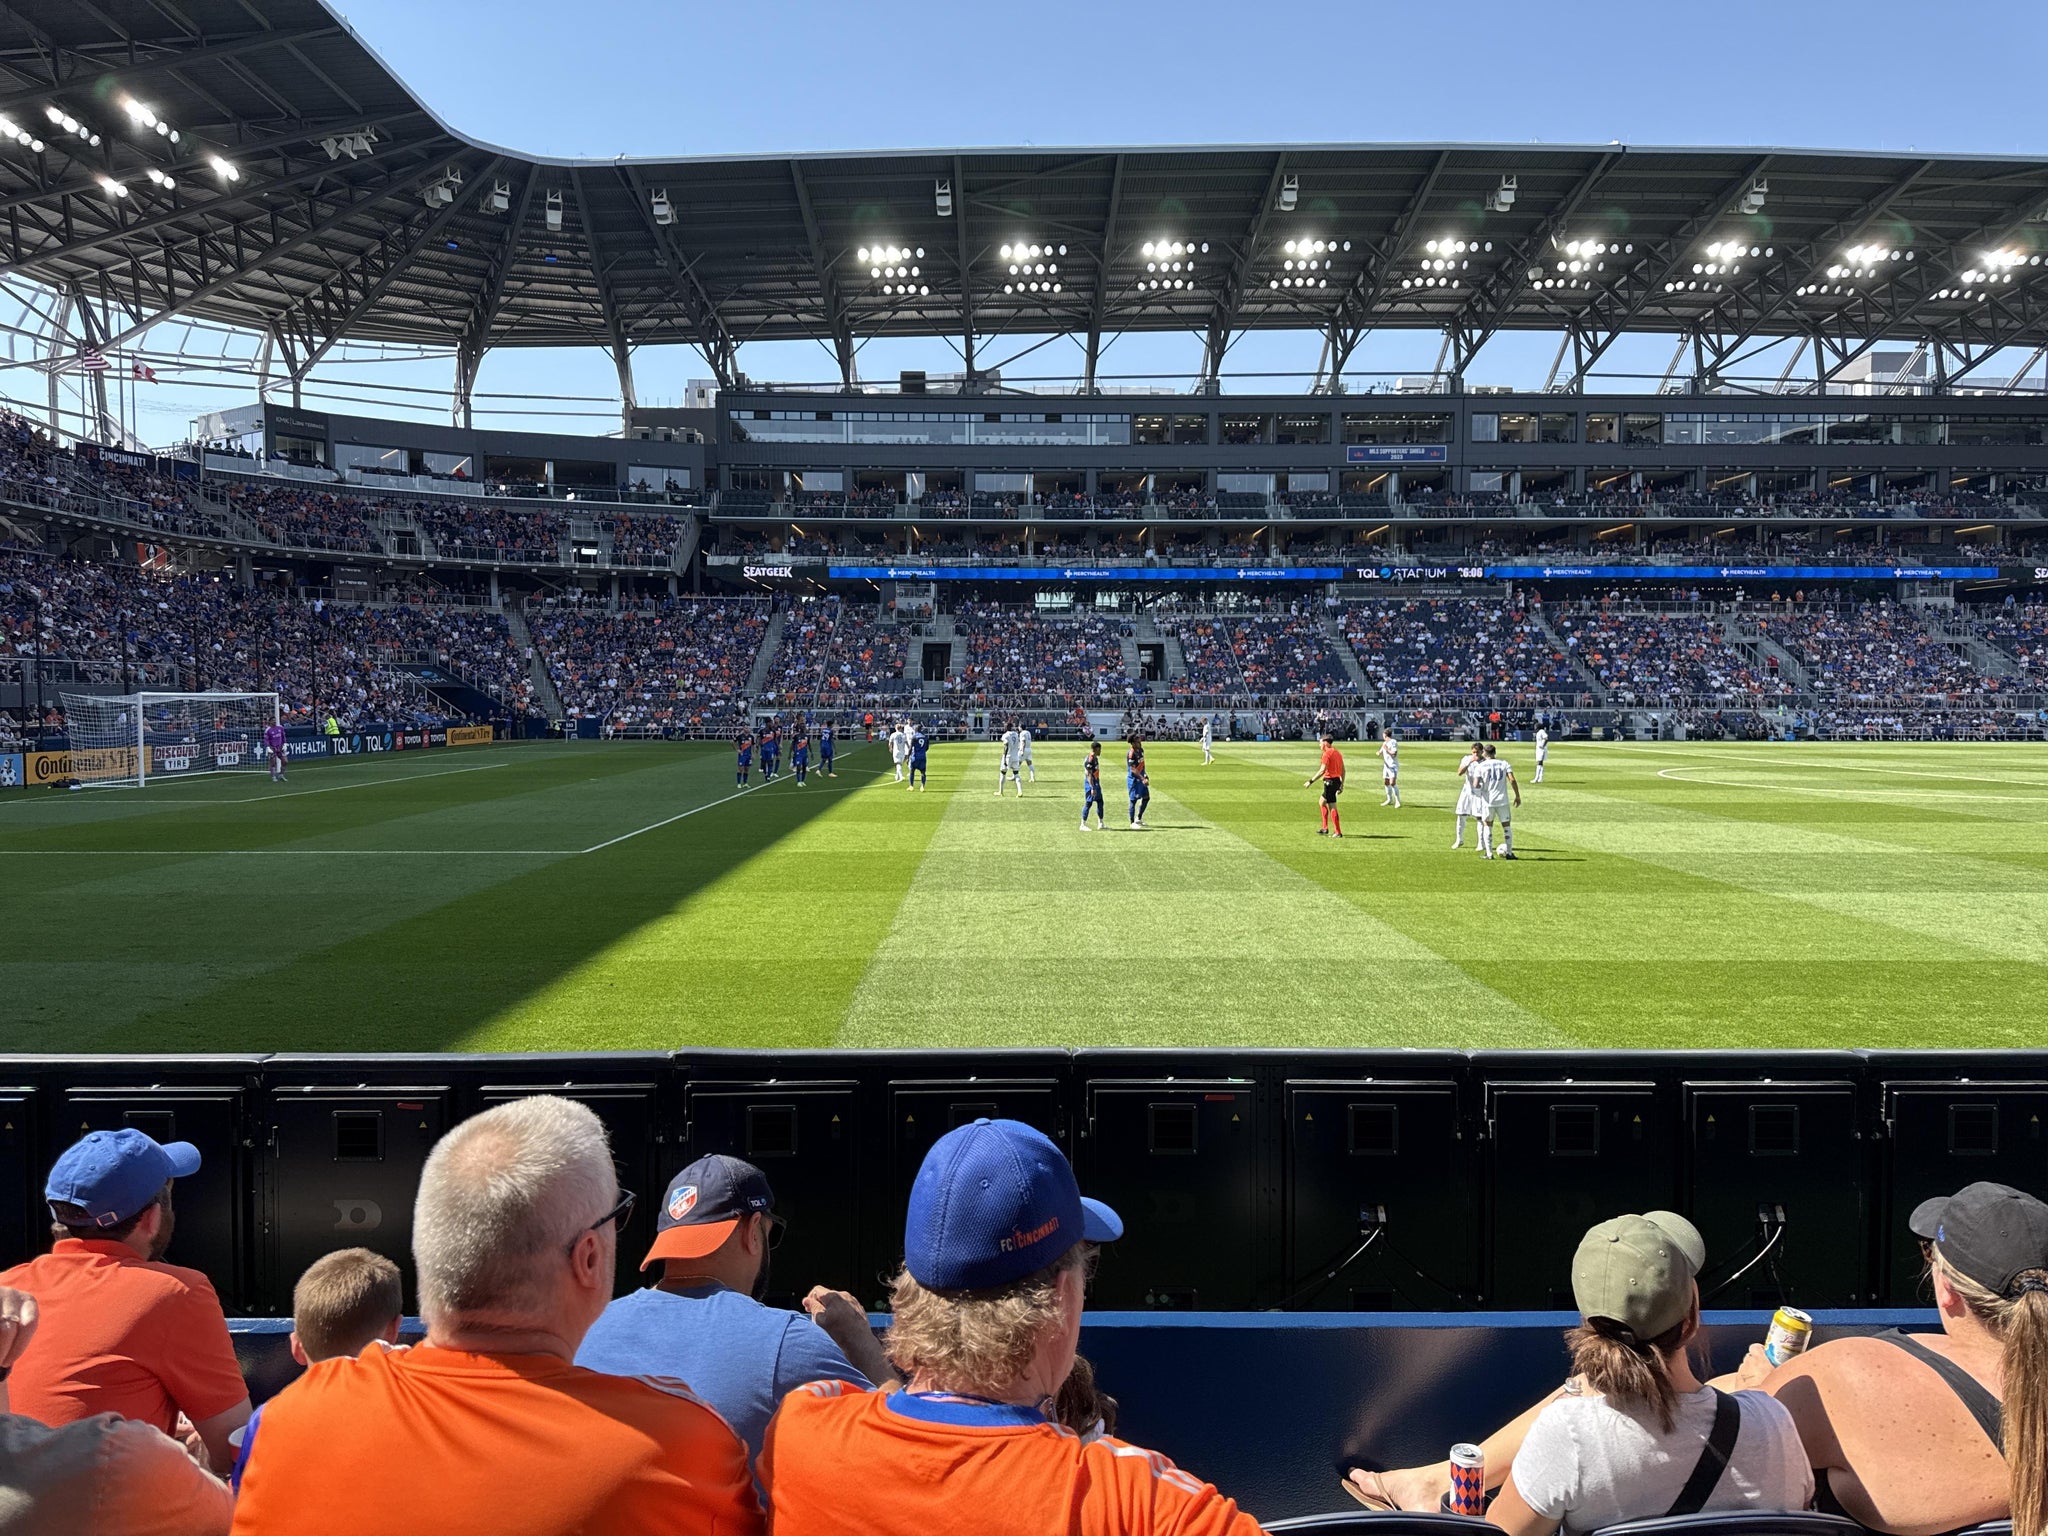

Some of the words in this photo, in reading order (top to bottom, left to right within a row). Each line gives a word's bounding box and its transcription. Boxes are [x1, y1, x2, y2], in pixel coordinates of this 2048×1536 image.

[99, 447, 147, 468] CINCINNATI
[743, 566, 793, 578] SEATGEEK
[1356, 568, 1380, 579] TQL
[366, 735, 384, 752] TQL
[404, 735, 421, 745] TOYOTA
[430, 733, 447, 743] TOYOTA
[918, 738, 925, 748] 9
[154, 744, 200, 760] DISCOUNT
[209, 741, 248, 756] DISCOUNT
[332, 738, 352, 754] TQL
[166, 758, 187, 769] TIRE
[219, 754, 237, 764] TIRE
[1000, 1237, 1013, 1253] FC
[1018, 1216, 1059, 1249] CINCINNATI
